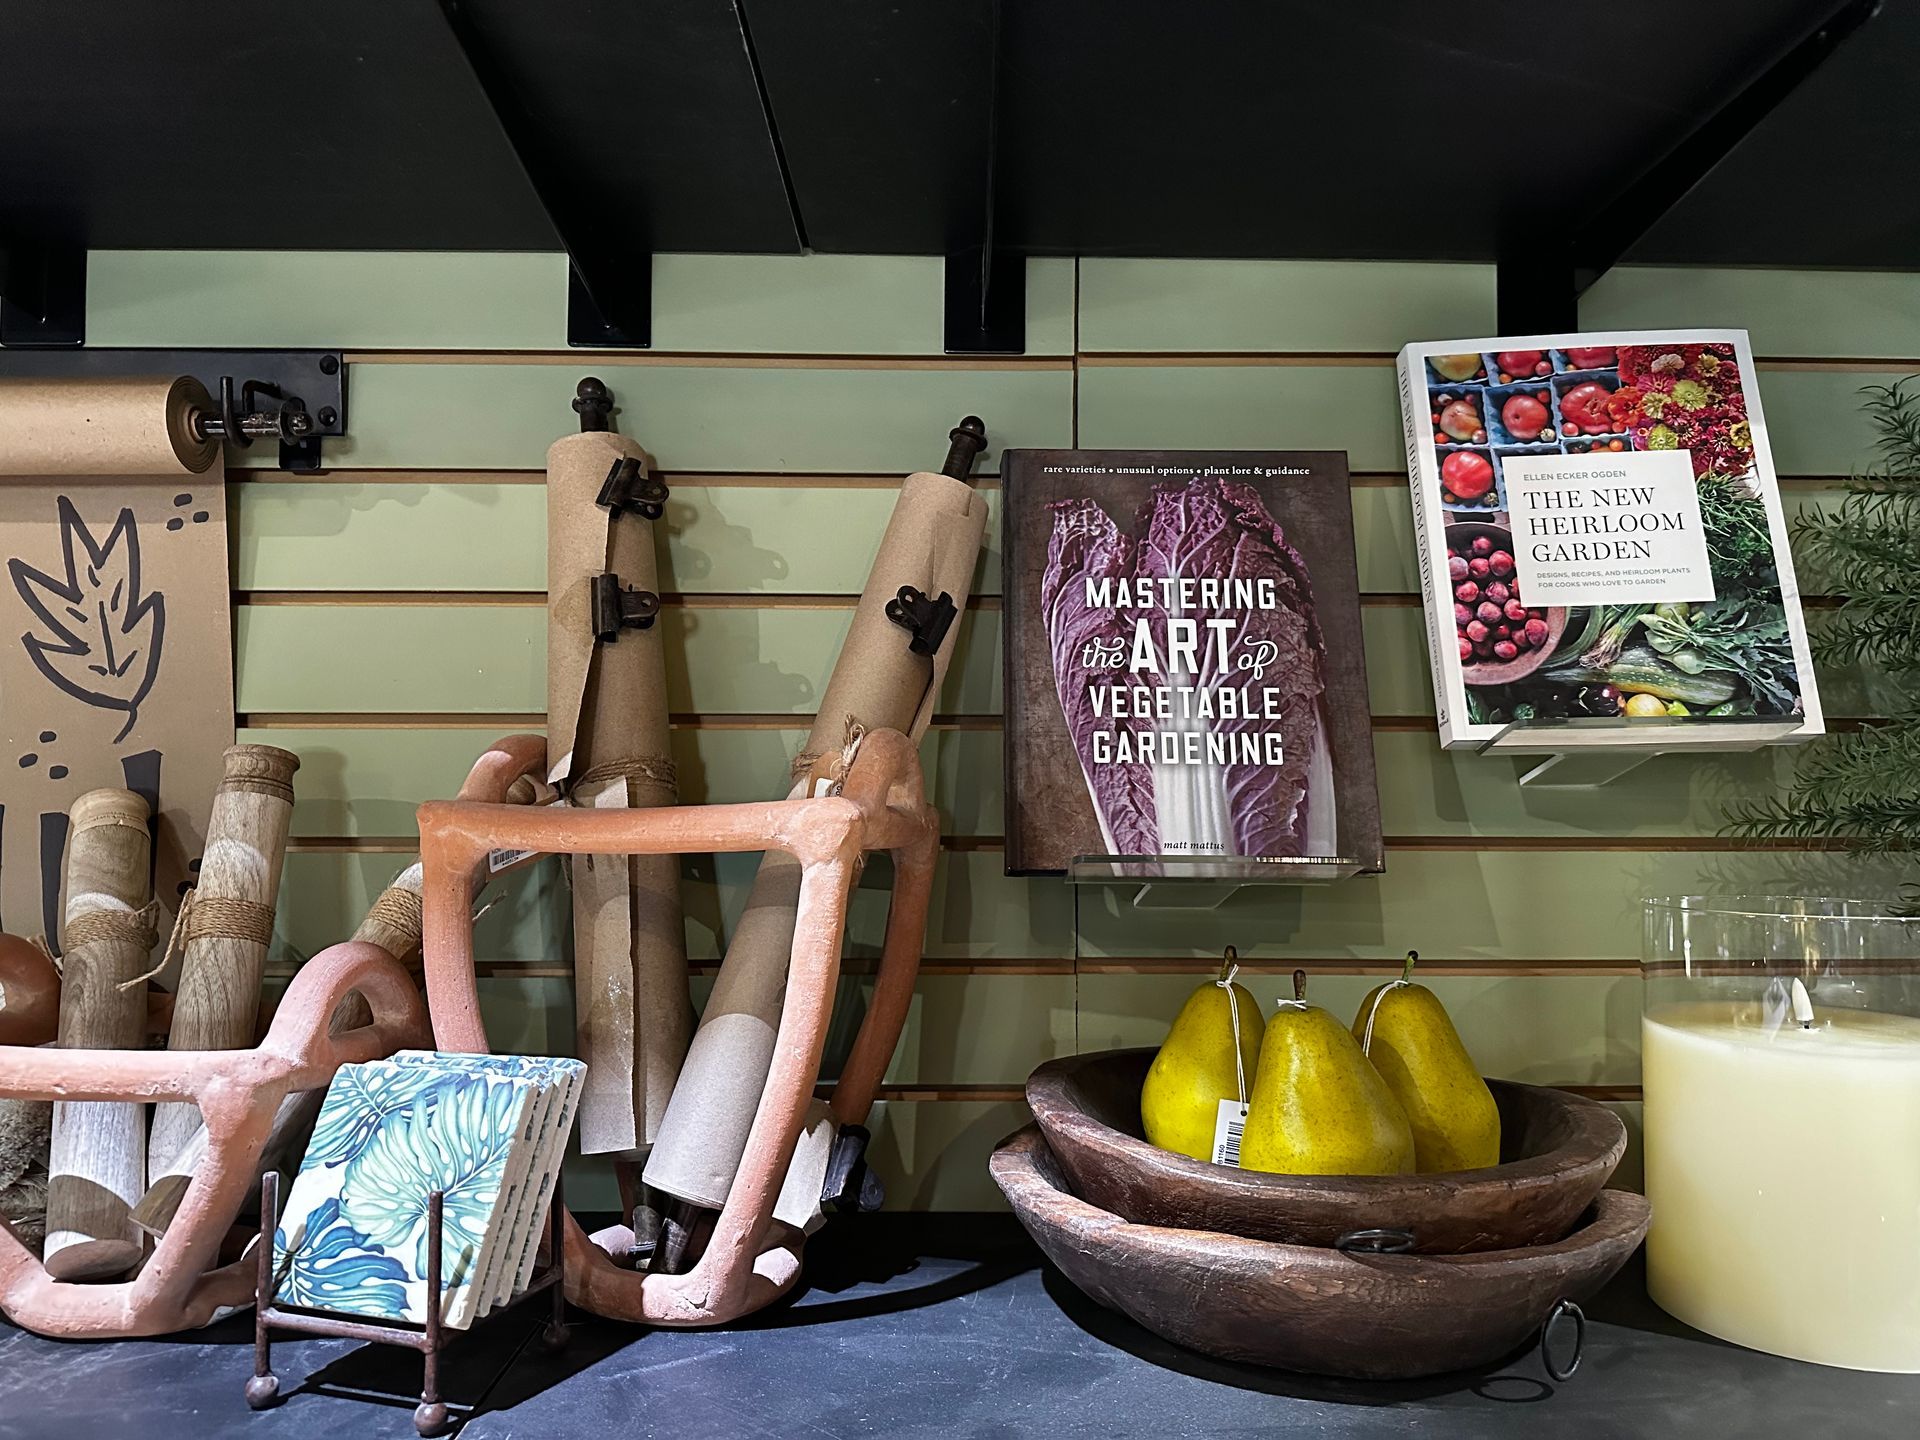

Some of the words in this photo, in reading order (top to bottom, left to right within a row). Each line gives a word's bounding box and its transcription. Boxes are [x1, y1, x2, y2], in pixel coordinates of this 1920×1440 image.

[1404, 403, 1413, 439] NEW
[1065, 465, 1106, 473] varieties
[1116, 465, 1154, 474] unusual
[1157, 466, 1194, 476] options
[1204, 465, 1230, 477] plant
[1232, 466, 1251, 475] lore
[1253, 467, 1263, 475] &
[1265, 466, 1310, 477] guidance
[1523, 473, 1554, 481] ELLEN
[1556, 472, 1588, 480] ECKER
[1591, 470, 1627, 479] OGDEN
[1408, 443, 1424, 531] HEIRLOOM
[1523, 490, 1583, 510] THE
[1592, 487, 1656, 507] NEW
[1530, 512, 1686, 536] HEIRLOOM
[1532, 540, 1652, 563] GARDEN
[1418, 534, 1433, 603] GARDEN
[1537, 571, 1570, 579] DESIGNS,
[1622, 568, 1661, 576] HEIRLOOM
[1085, 577, 1276, 609] MASTERING
[1082, 636, 1126, 668] the
[1129, 618, 1236, 674] ART
[1237, 635, 1278, 680] of
[1089, 686, 1281, 720] VEGETABLE
[1093, 731, 1284, 766] GARDENING
[1164, 841, 1187, 849] matt
[1190, 842, 1225, 850] mattus
